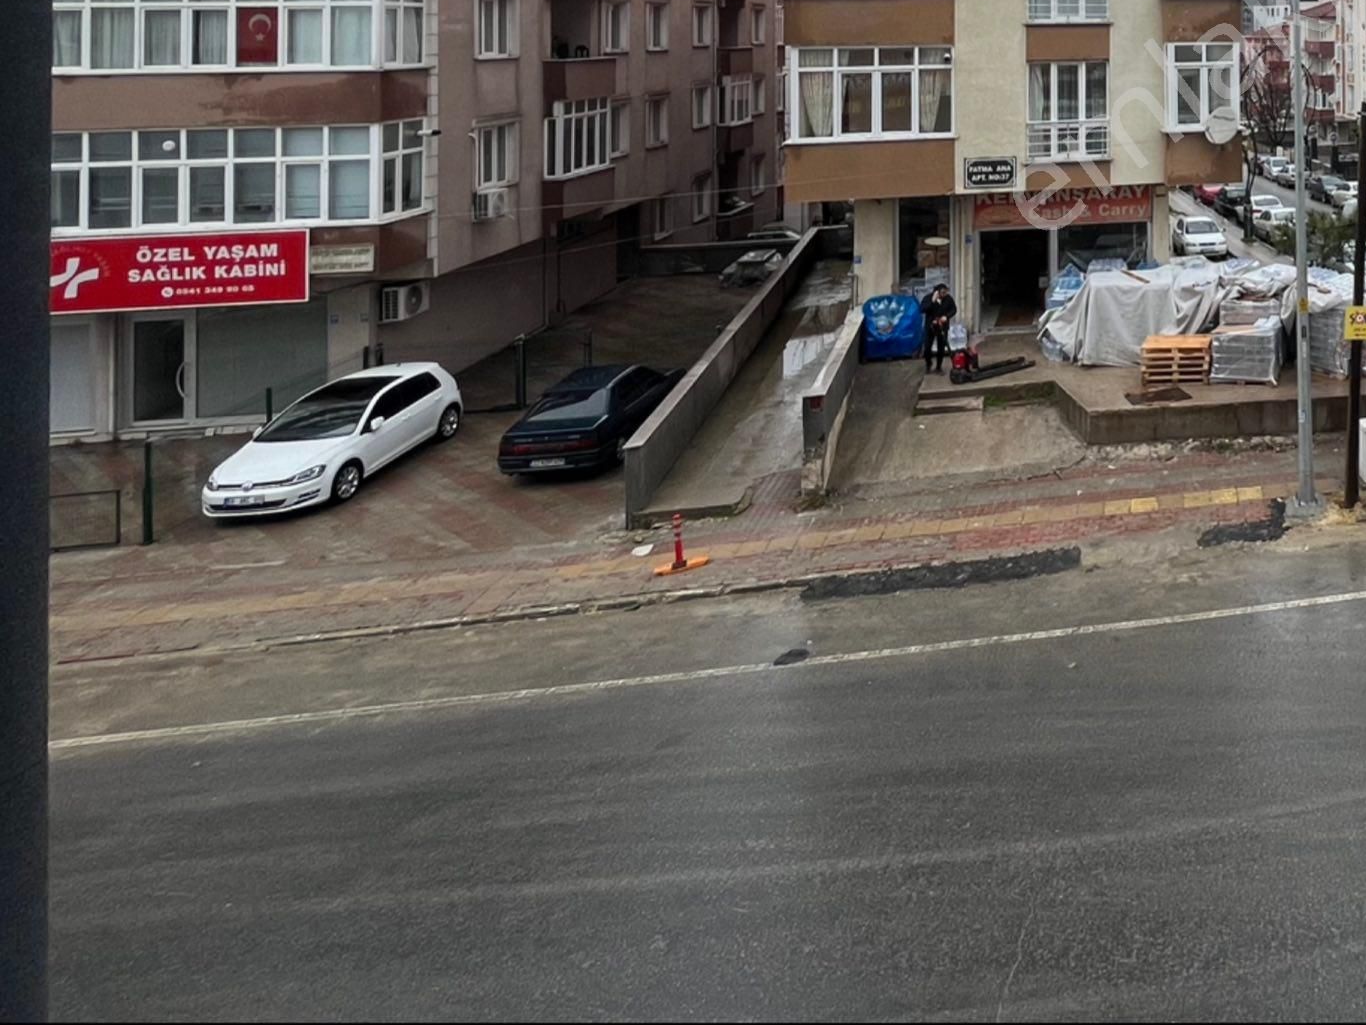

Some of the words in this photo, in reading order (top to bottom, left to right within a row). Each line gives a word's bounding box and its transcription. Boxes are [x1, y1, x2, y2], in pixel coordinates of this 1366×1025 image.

[969, 165, 993, 173] FATMA
[1098, 203, 1147, 218] Carry
[136, 245, 196, 263] ÖZEL
[203, 243, 278, 264] YAŞAM
[127, 264, 210, 283] SAĞLIK
[214, 260, 286, 278] KABİNİ
